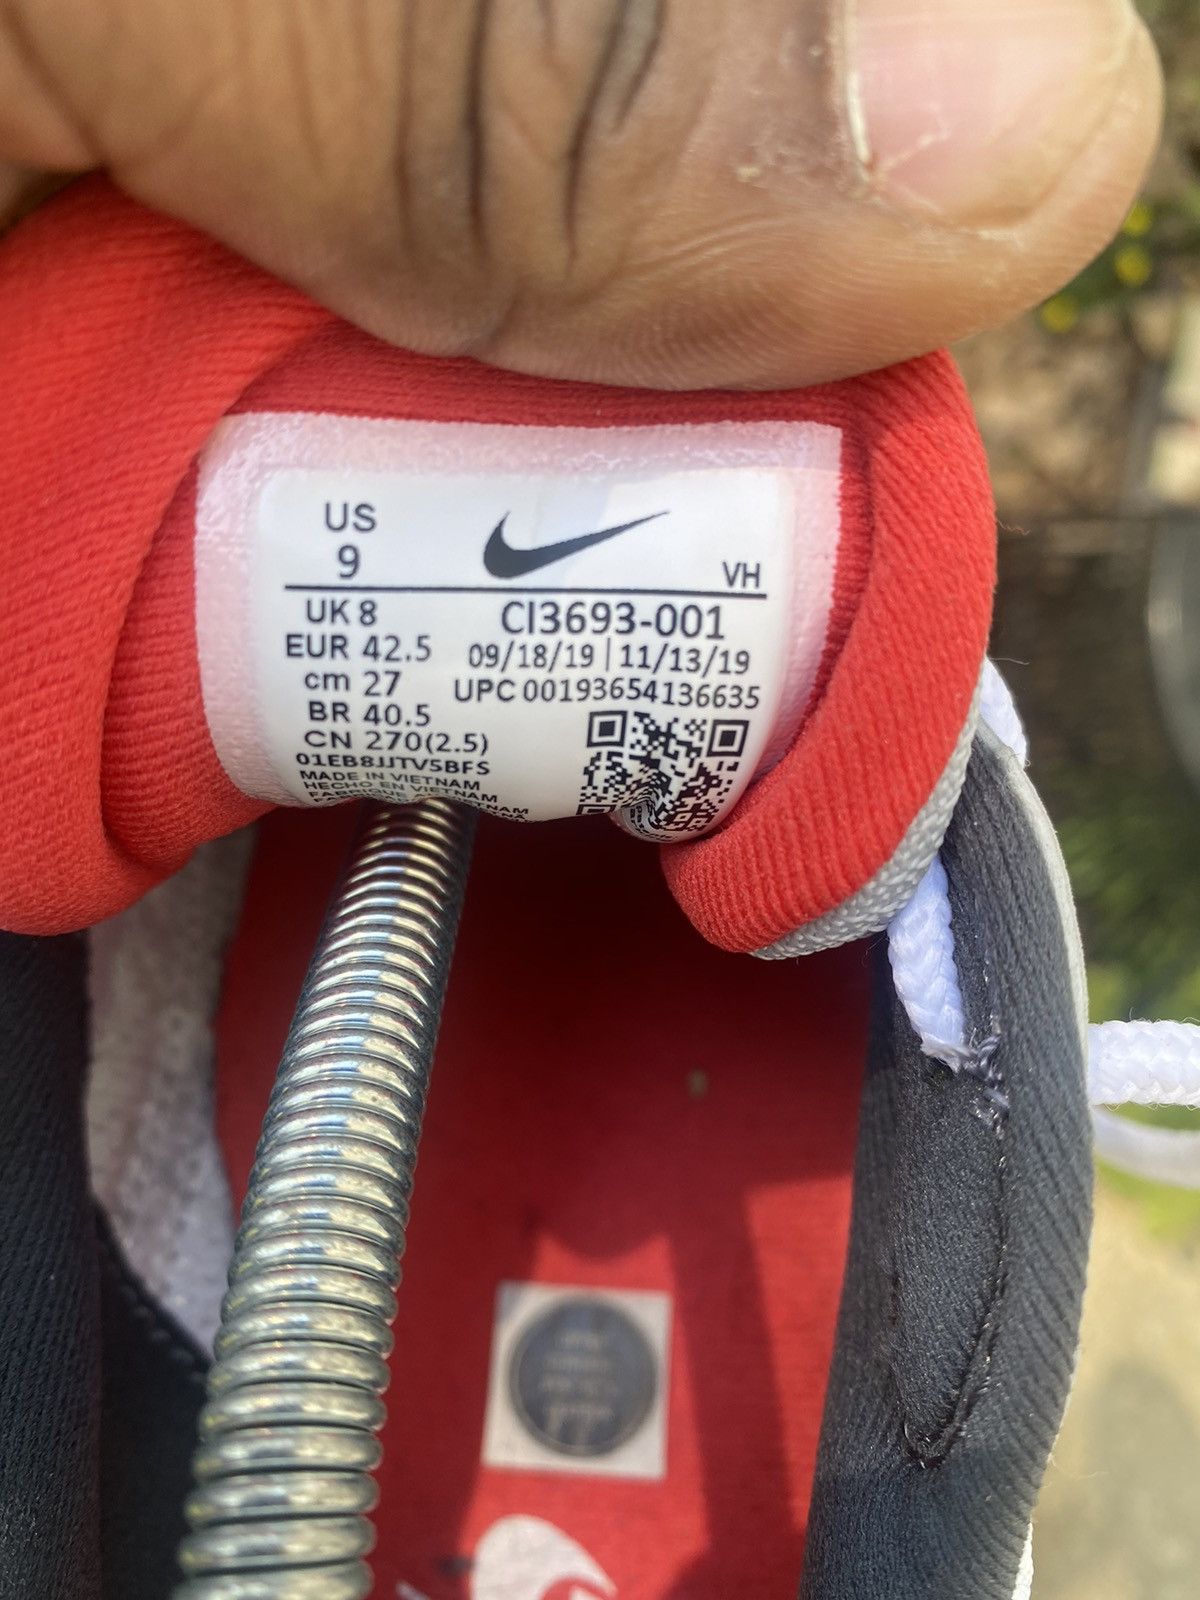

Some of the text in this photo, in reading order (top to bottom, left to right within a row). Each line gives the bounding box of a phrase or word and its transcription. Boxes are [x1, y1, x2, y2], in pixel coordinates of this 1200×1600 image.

[325, 502, 377, 532] US
[338, 544, 360, 579] 9
[722, 561, 761, 589] VH
[306, 599, 377, 626] UK 8
[501, 601, 725, 640] CI3693-001
[286, 634, 431, 663] EUR 42.5
[468, 641, 750, 678] 09/18/19 11/13/19
[304, 670, 400, 696] cm 27
[454, 677, 760, 709] UPC 00193654136635
[309, 701, 430, 727] BR 40.5
[304, 730, 488, 755] CN 270(2.5)
[300, 770, 480, 791] MADE IN VIETNAM
[303, 781, 372, 790] HECHO
[380, 781, 405, 791] EN
[410, 785, 498, 803] VIETNAM
